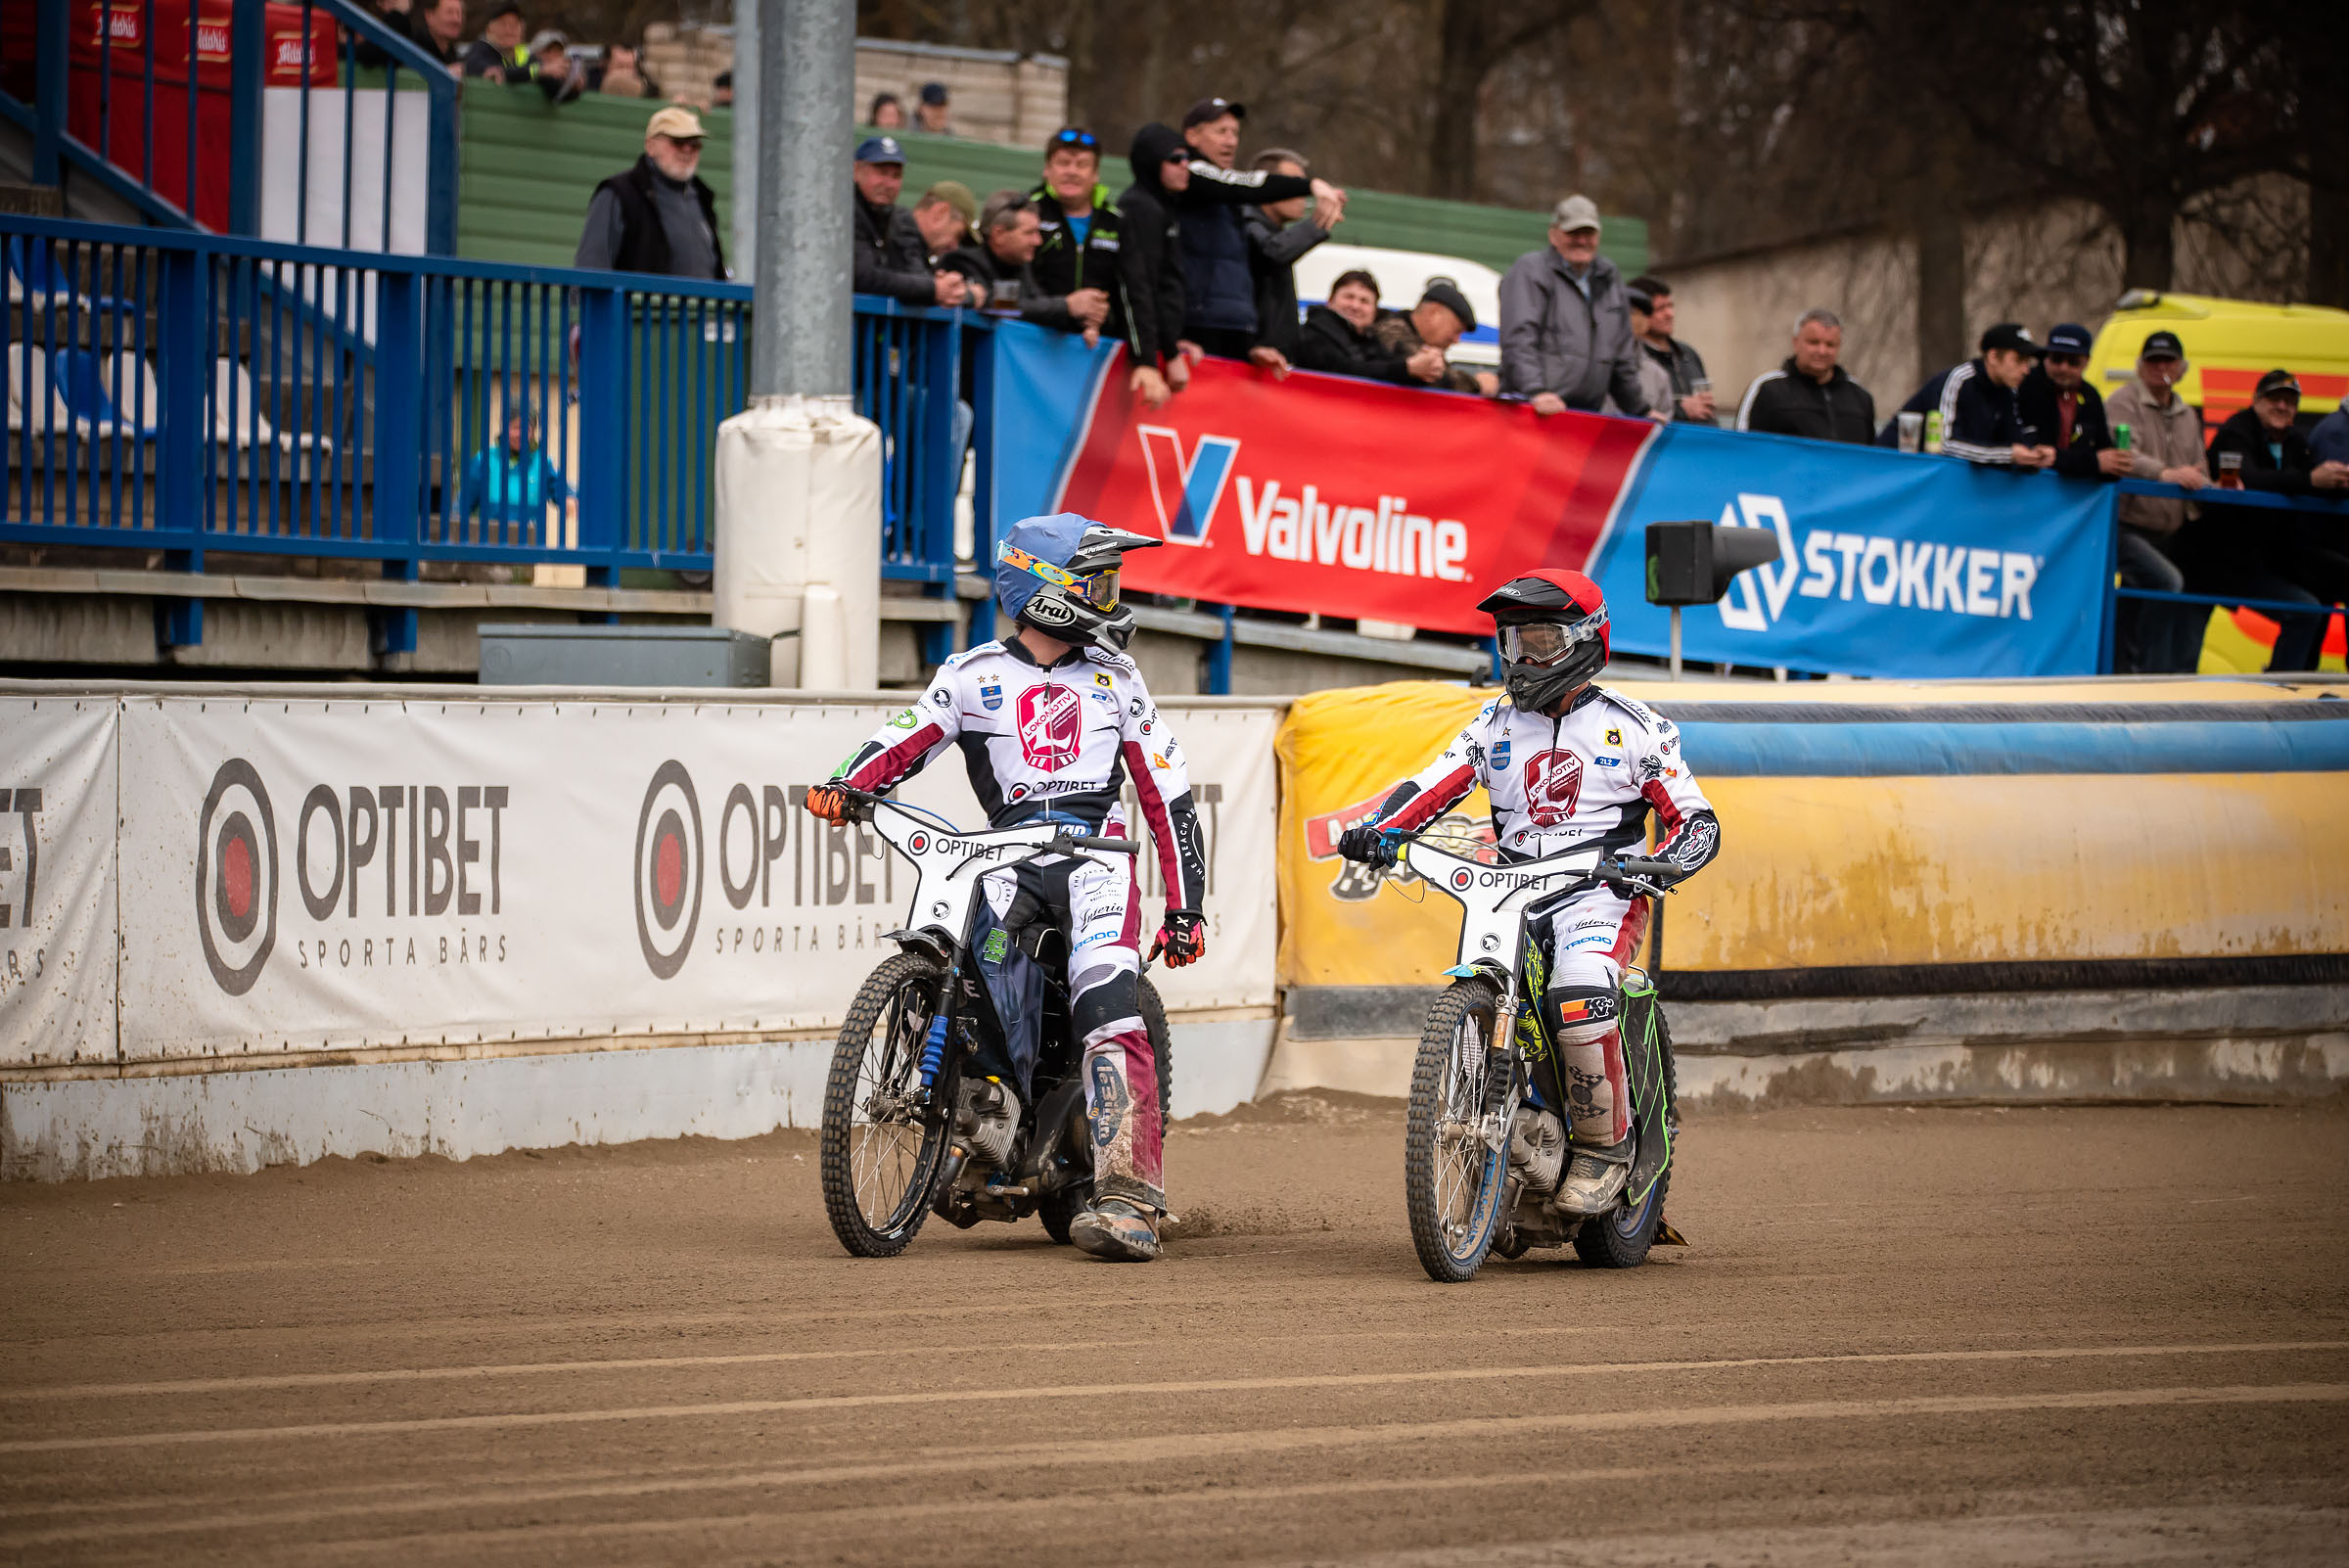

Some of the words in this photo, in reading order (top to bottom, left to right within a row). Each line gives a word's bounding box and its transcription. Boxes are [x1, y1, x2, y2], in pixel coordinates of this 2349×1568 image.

[1235, 475, 1468, 582] Valvoline
[1799, 529, 2033, 621] STOKKER
[1028, 597, 1070, 620] Arai
[1024, 692, 1072, 737] LOKOMOTIV
[1531, 759, 1576, 798] LOKOMOTIV
[298, 783, 509, 922] OPTIBET
[936, 838, 1005, 861] OPTIBET
[1180, 822, 1192, 856] BEACH
[1479, 872, 1550, 891] OPTIBET
[299, 937, 416, 969] SPORTA
[438, 927, 507, 965] BĀRS
[715, 924, 819, 954] SPORTA
[1176, 916, 1190, 955] FOX
[1564, 936, 1612, 950] TRODO
